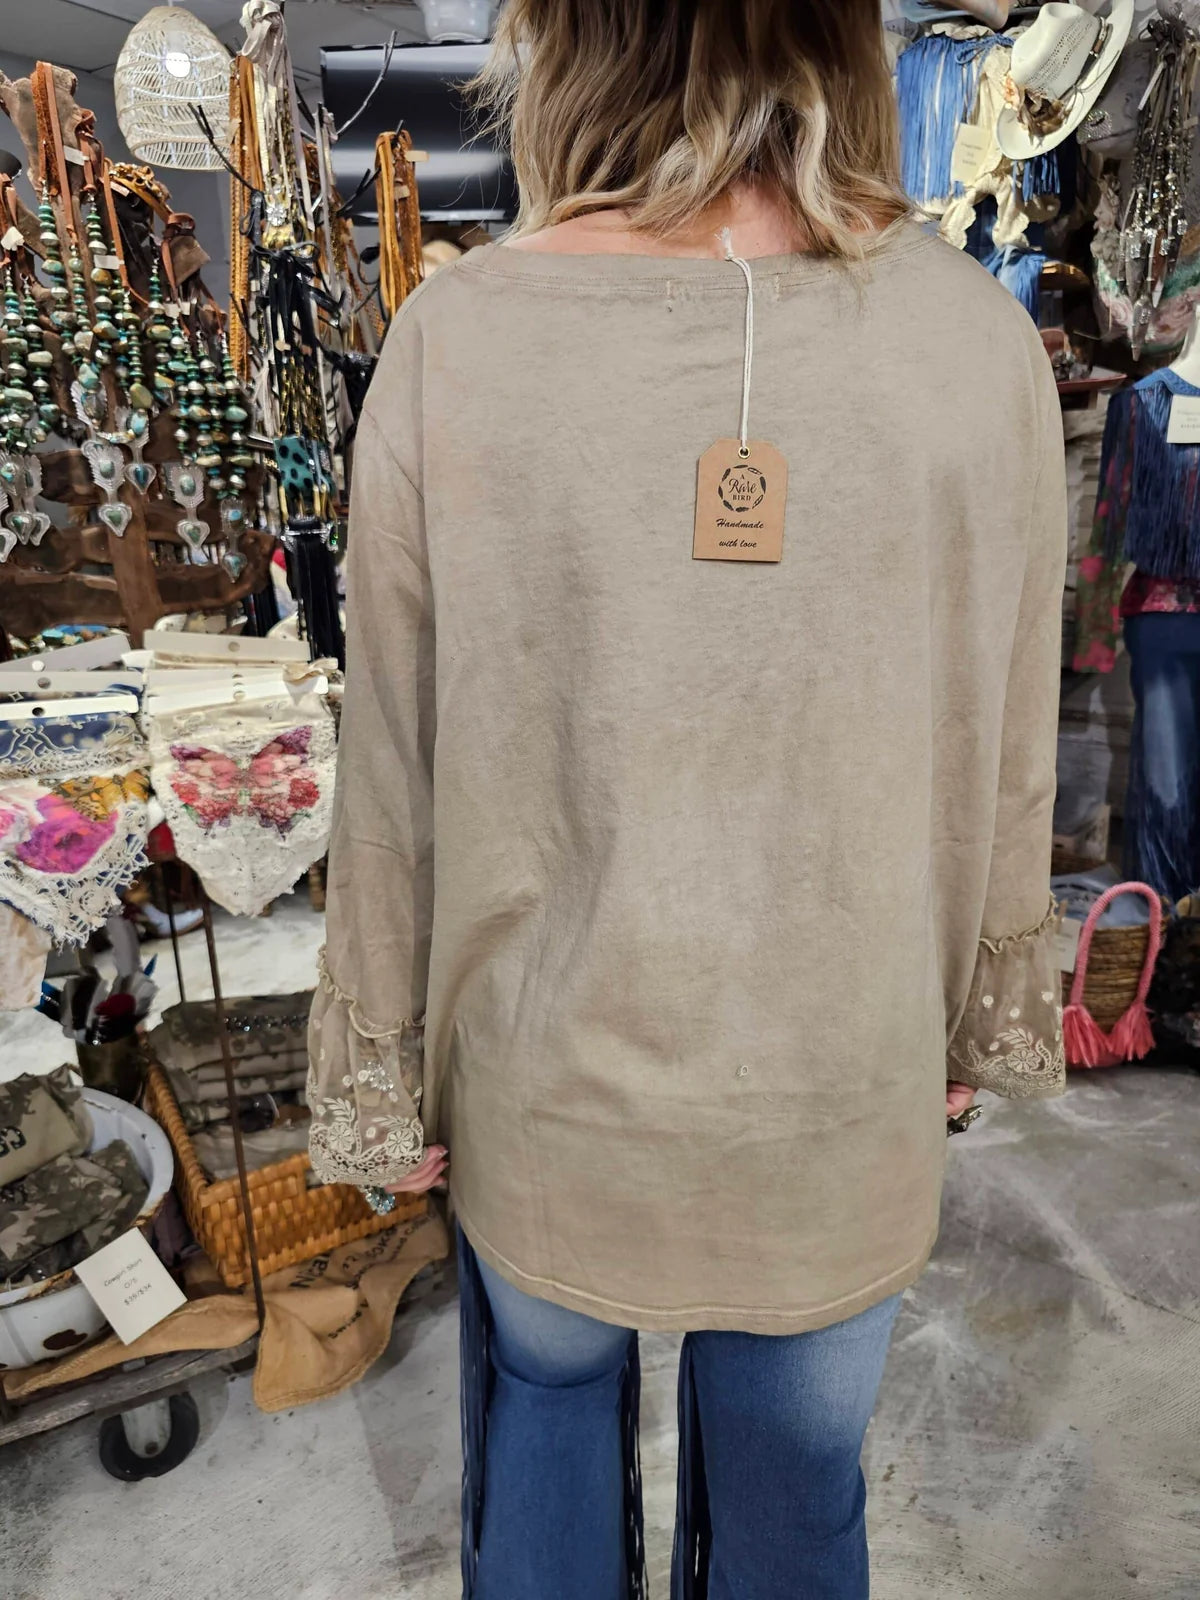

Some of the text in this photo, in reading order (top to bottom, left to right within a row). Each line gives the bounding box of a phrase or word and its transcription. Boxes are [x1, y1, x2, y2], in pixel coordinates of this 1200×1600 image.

[729, 478, 756, 493] Rare
[716, 519, 764, 528] Handmade
[718, 538, 757, 548] with love
